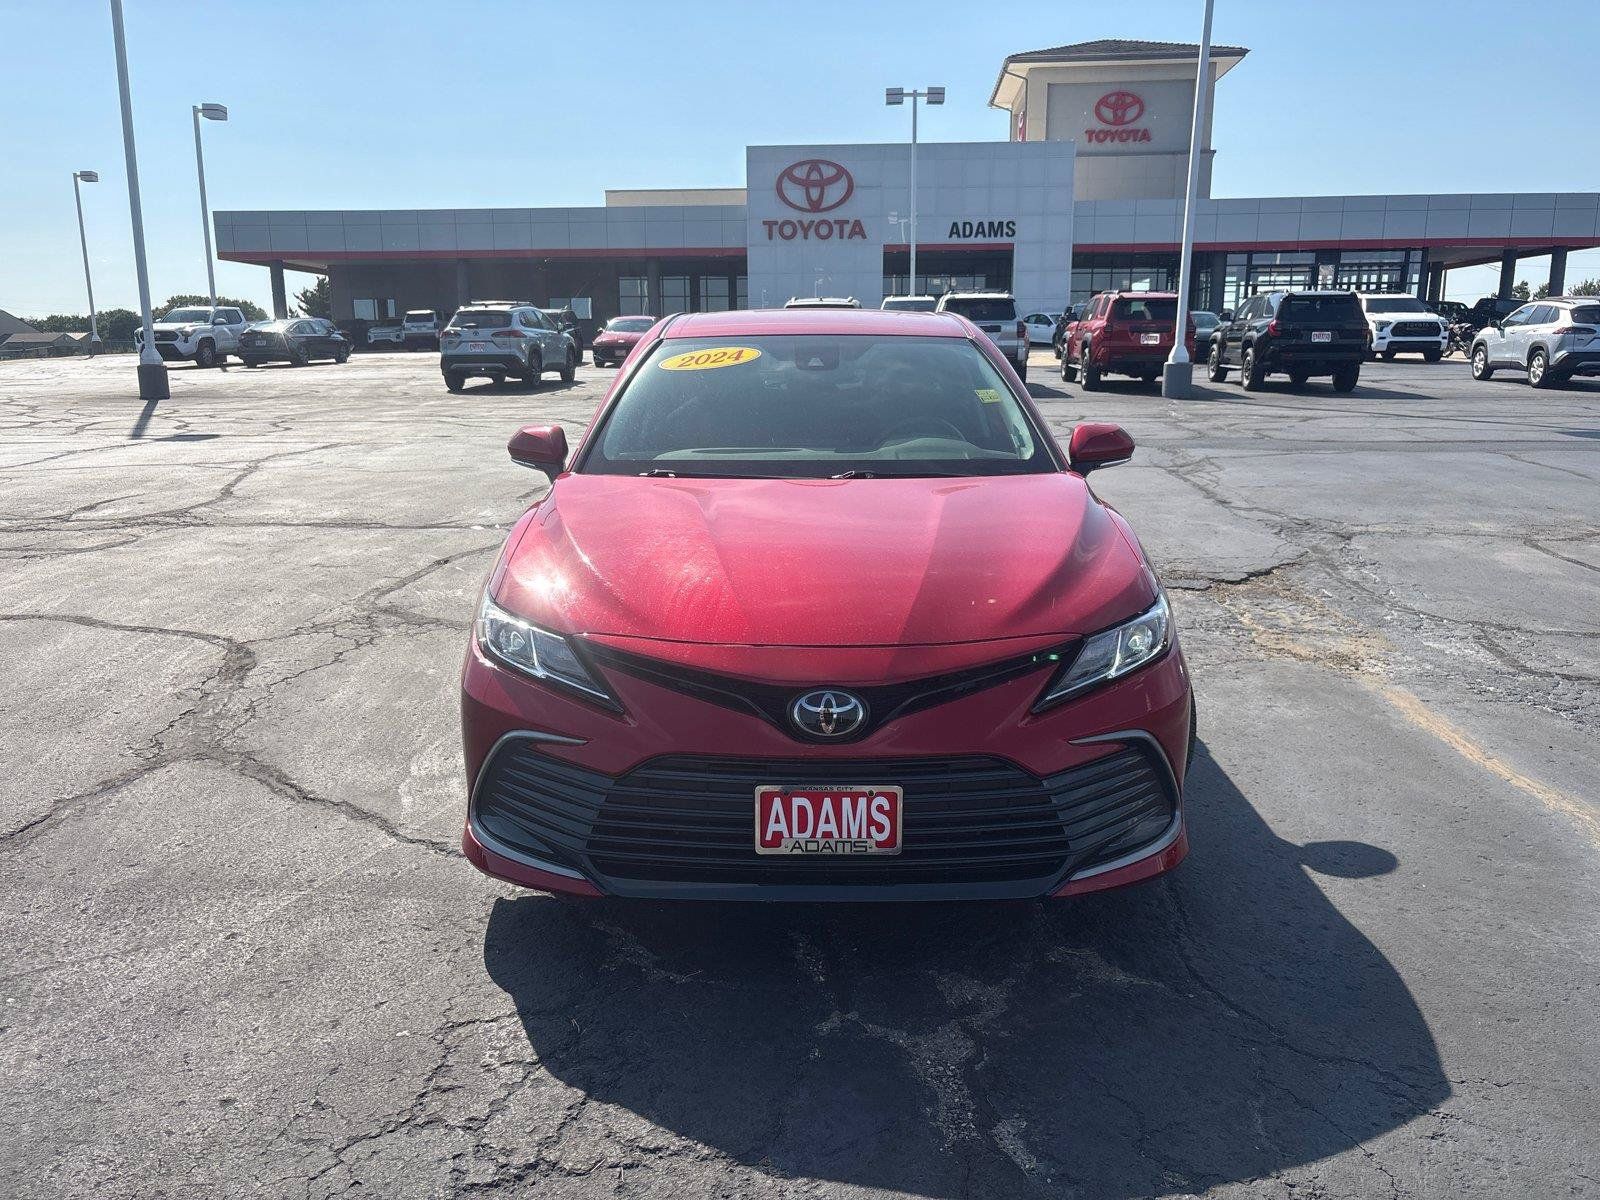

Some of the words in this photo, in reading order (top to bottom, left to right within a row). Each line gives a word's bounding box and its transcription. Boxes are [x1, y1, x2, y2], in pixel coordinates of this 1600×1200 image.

[1085, 128, 1153, 143] TOYOTA
[762, 219, 867, 240] TOYOTA
[948, 220, 1016, 238] ADAMS
[677, 349, 745, 368] 2024
[765, 796, 891, 842] ADAMS
[790, 840, 868, 852] ADAMS
